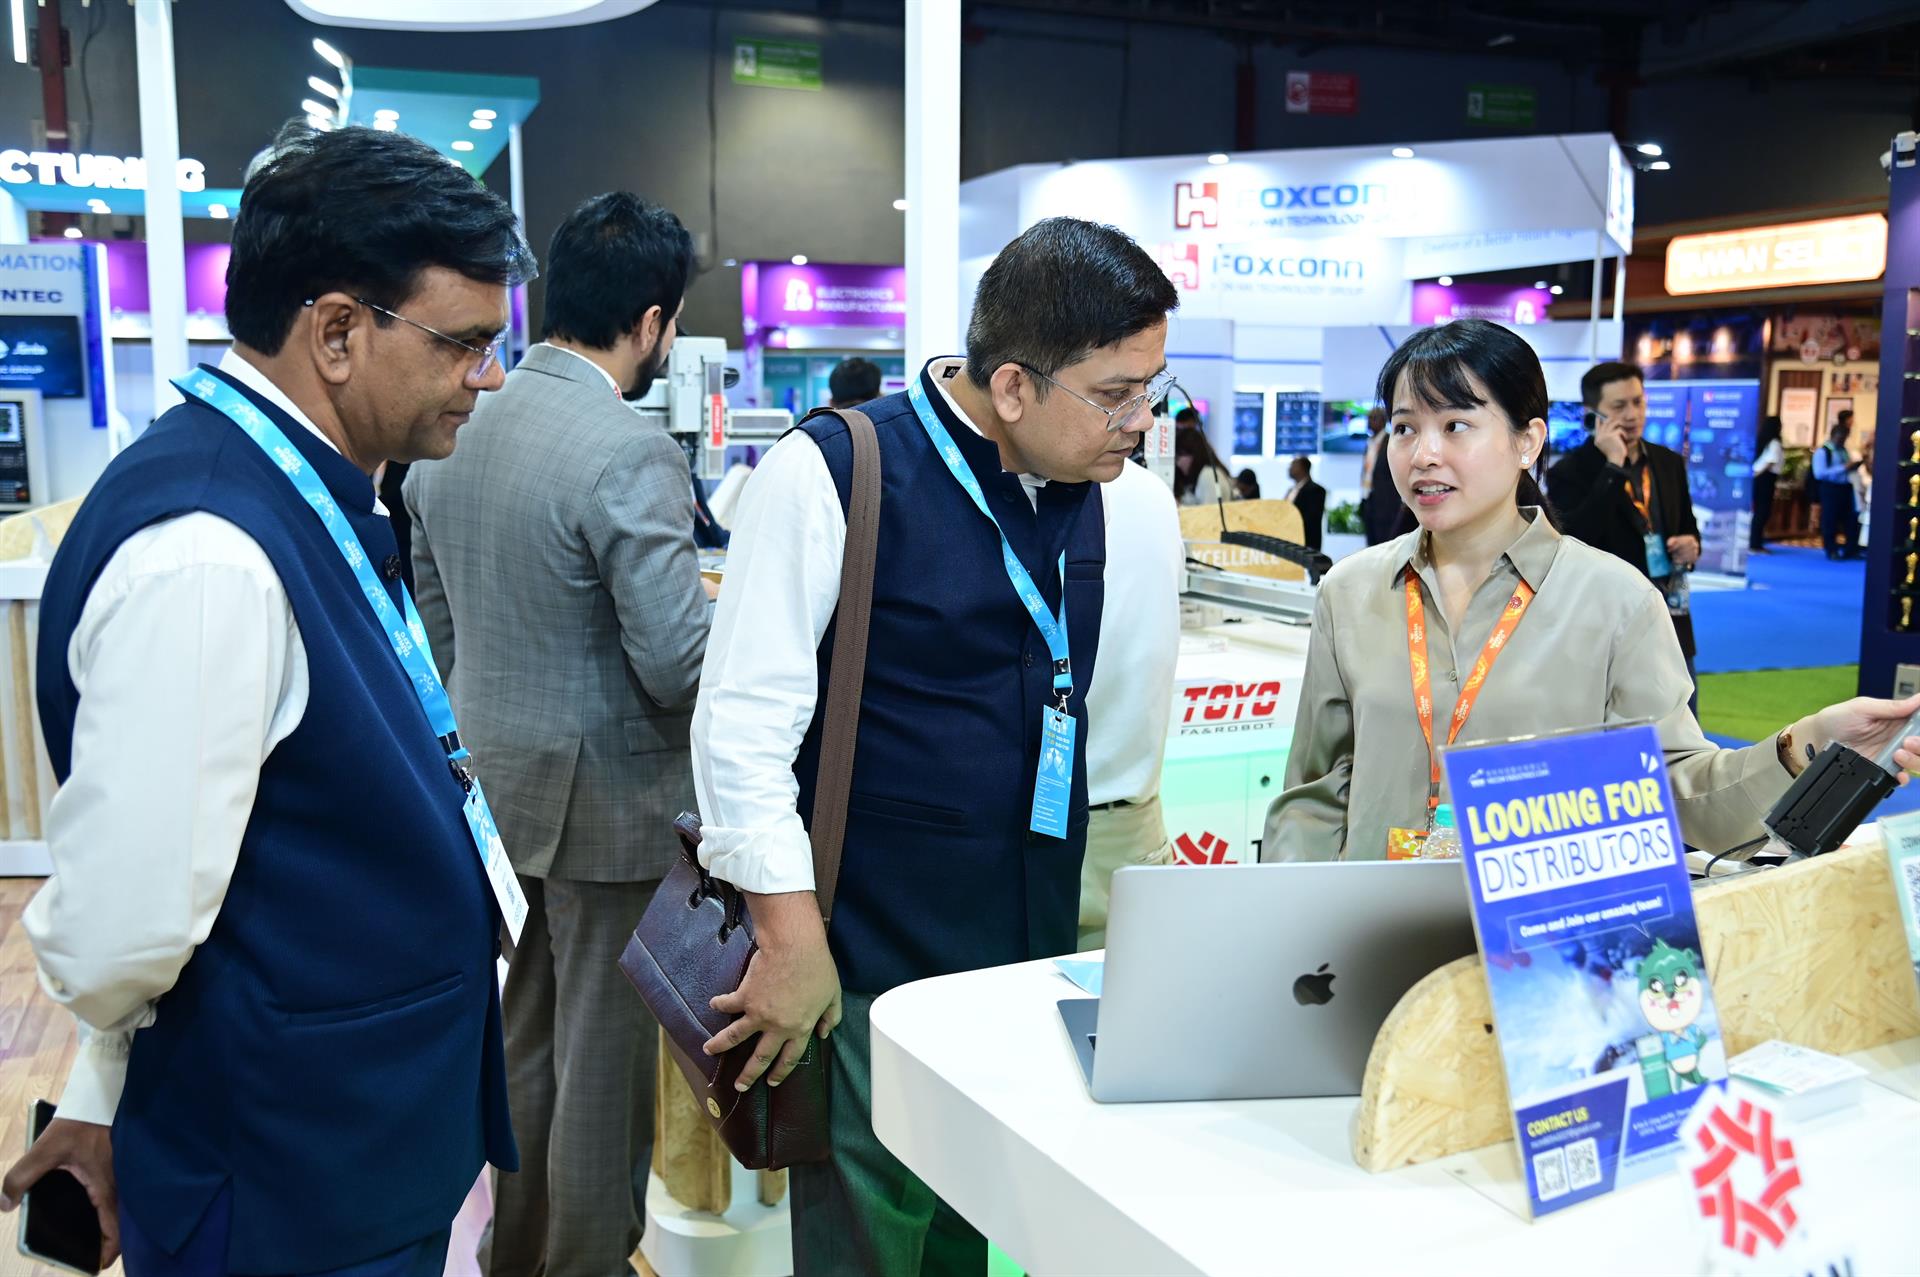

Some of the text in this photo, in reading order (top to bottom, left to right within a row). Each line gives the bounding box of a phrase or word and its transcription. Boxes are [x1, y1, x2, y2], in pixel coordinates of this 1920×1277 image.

[0, 150, 206, 192] CTURIG
[1183, 681, 1281, 722] TOYO
[1180, 722, 1275, 736] FA&ROBOT
[1466, 777, 1664, 846] LOOKING FOR
[1482, 824, 1671, 894] DISTRIBUTORS
[1547, 917, 1566, 932] and
[1527, 1110, 1575, 1137] CONTACT
[1574, 1106, 1590, 1123] US
